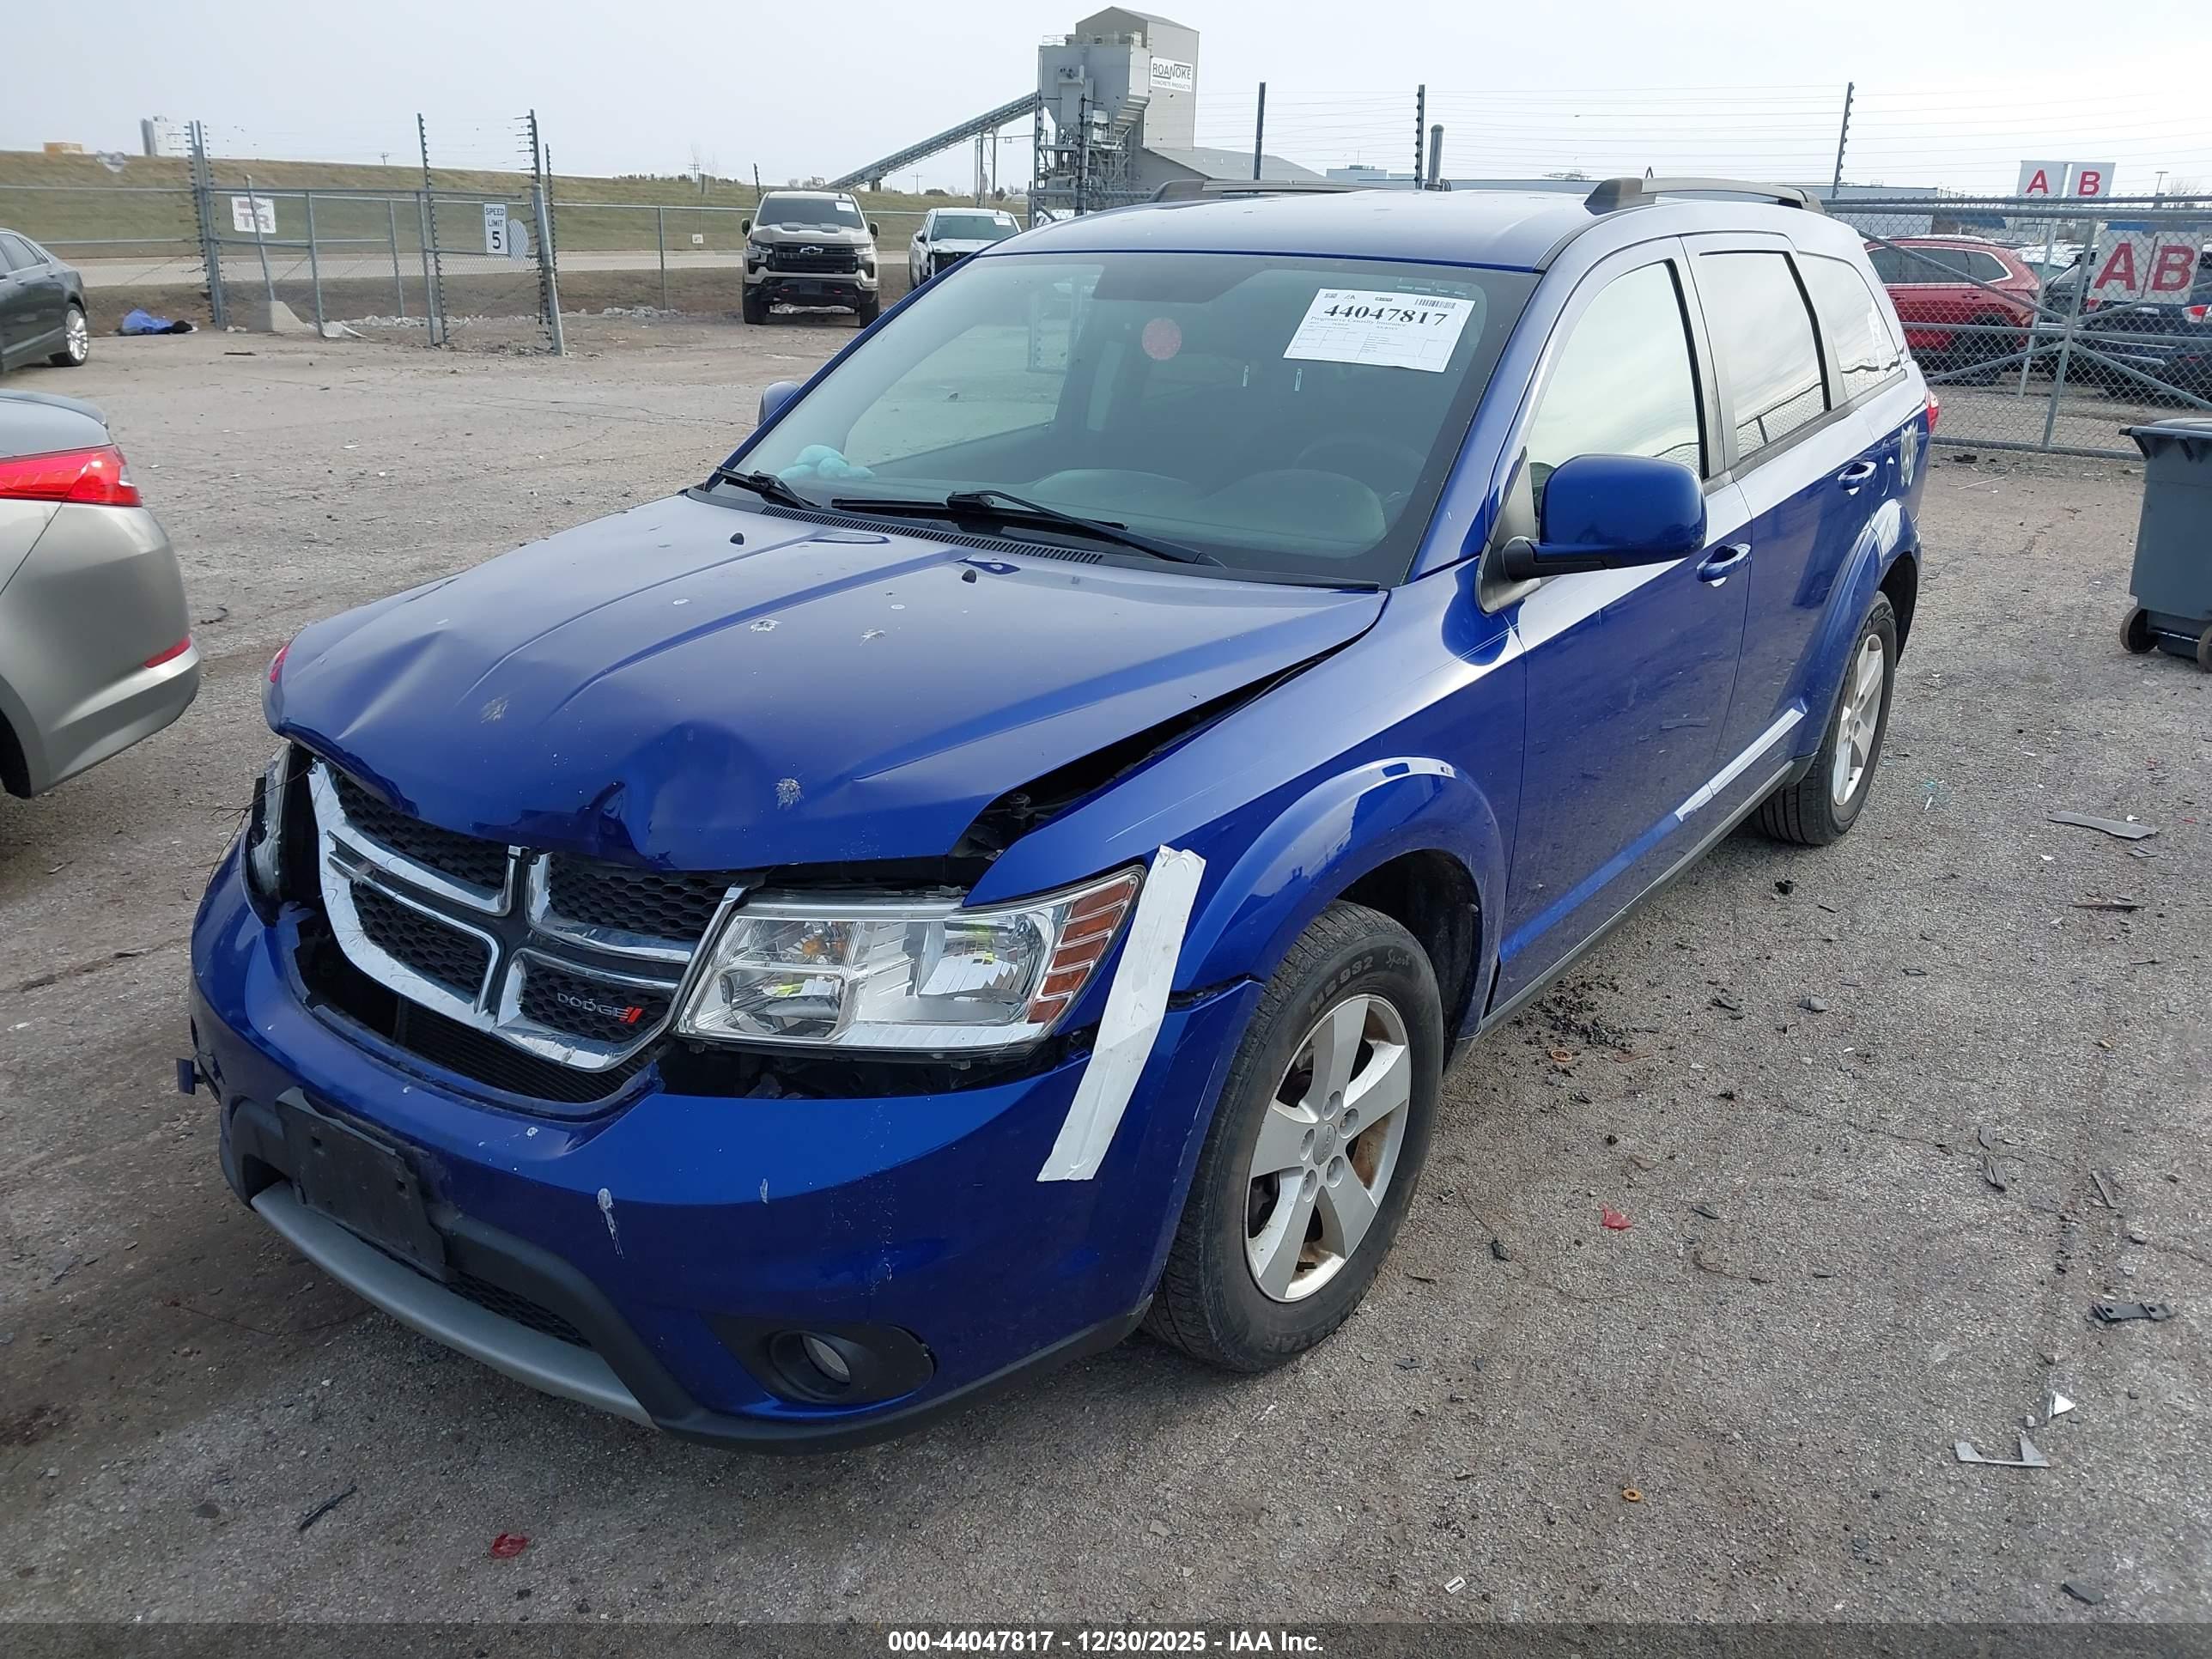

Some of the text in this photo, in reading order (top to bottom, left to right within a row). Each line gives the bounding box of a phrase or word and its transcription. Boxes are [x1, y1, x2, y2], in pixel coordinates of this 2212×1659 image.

[1152, 63, 1192, 80] ROANOKE
[2026, 170, 2101, 196] A B
[485, 208, 505, 216] SPEED
[487, 219, 503, 228] LIMIT
[491, 230, 502, 251] 5
[2093, 242, 2196, 292] A B
[1323, 303, 1449, 326] 44047817
[556, 992, 630, 1019] DODGE
